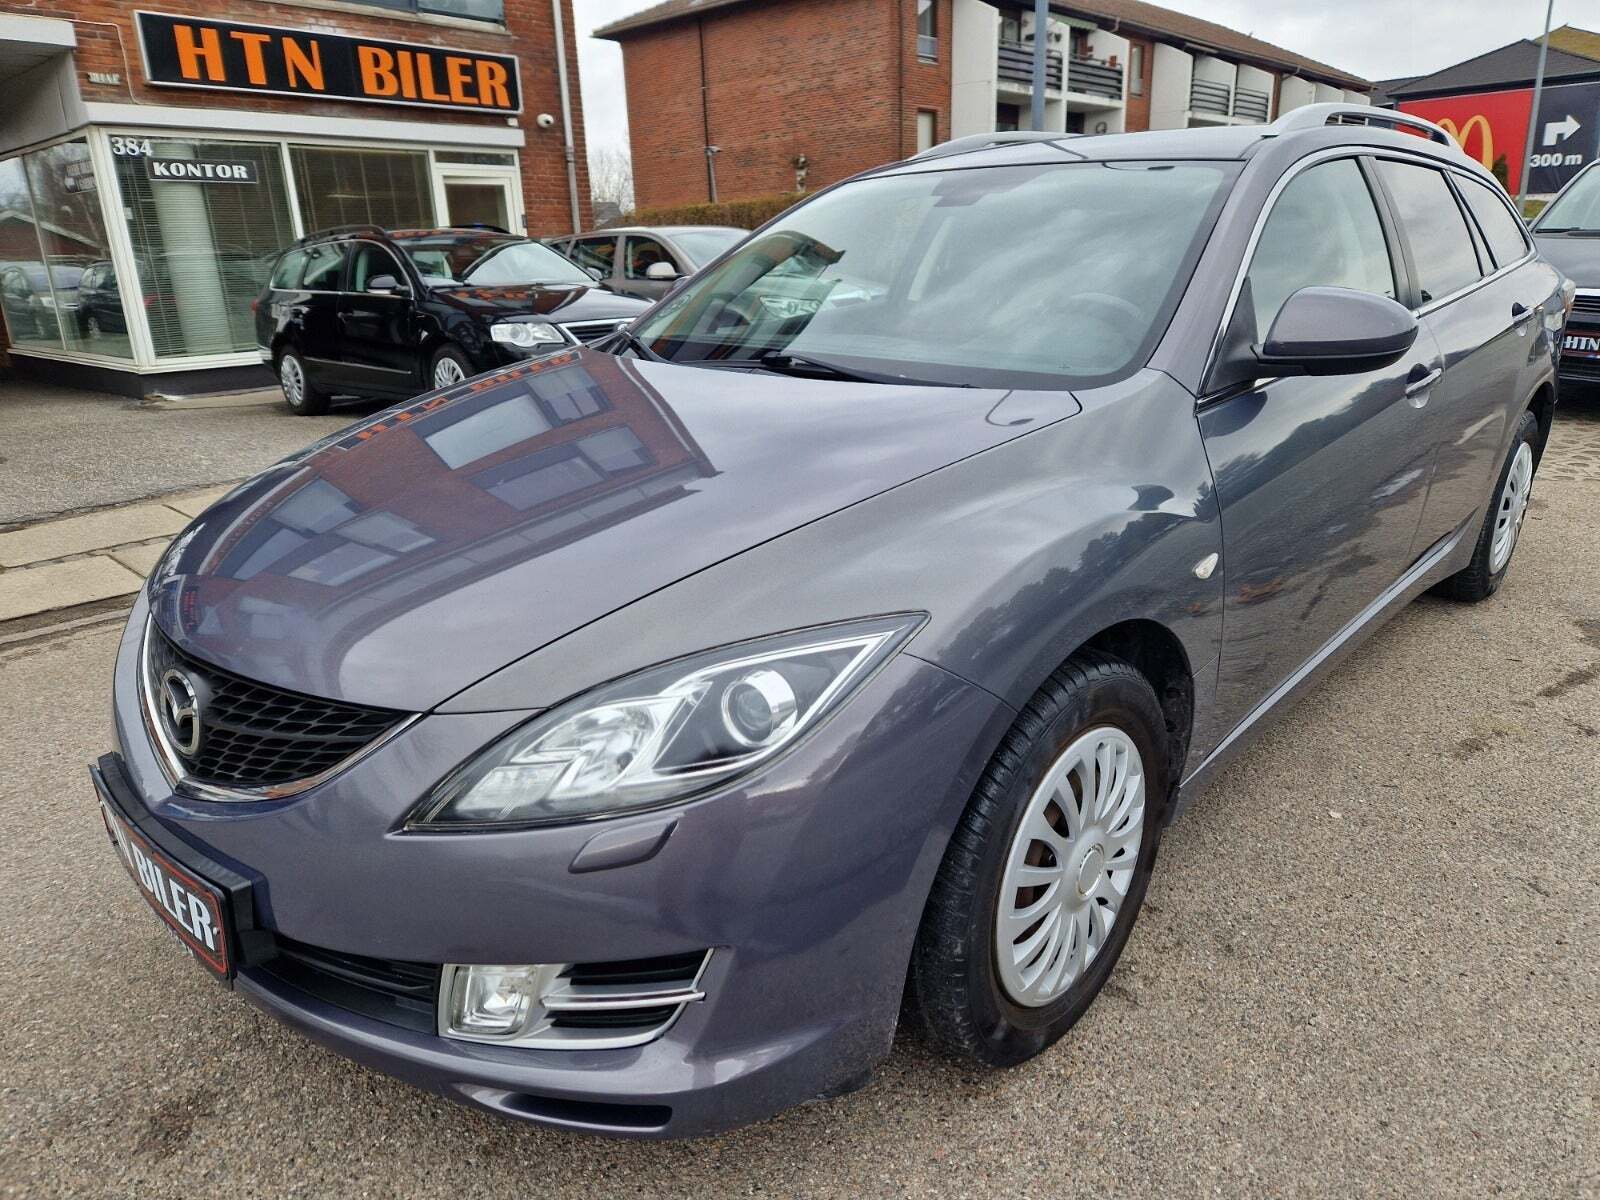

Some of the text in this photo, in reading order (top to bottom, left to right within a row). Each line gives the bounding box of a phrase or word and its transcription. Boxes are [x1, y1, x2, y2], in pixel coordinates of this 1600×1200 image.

[173, 24, 511, 107] HTN BILER
[111, 136, 153, 157] 384
[152, 161, 249, 179] KONTOR
[1530, 153, 1583, 168] 300 m
[131, 841, 215, 951] BILER
